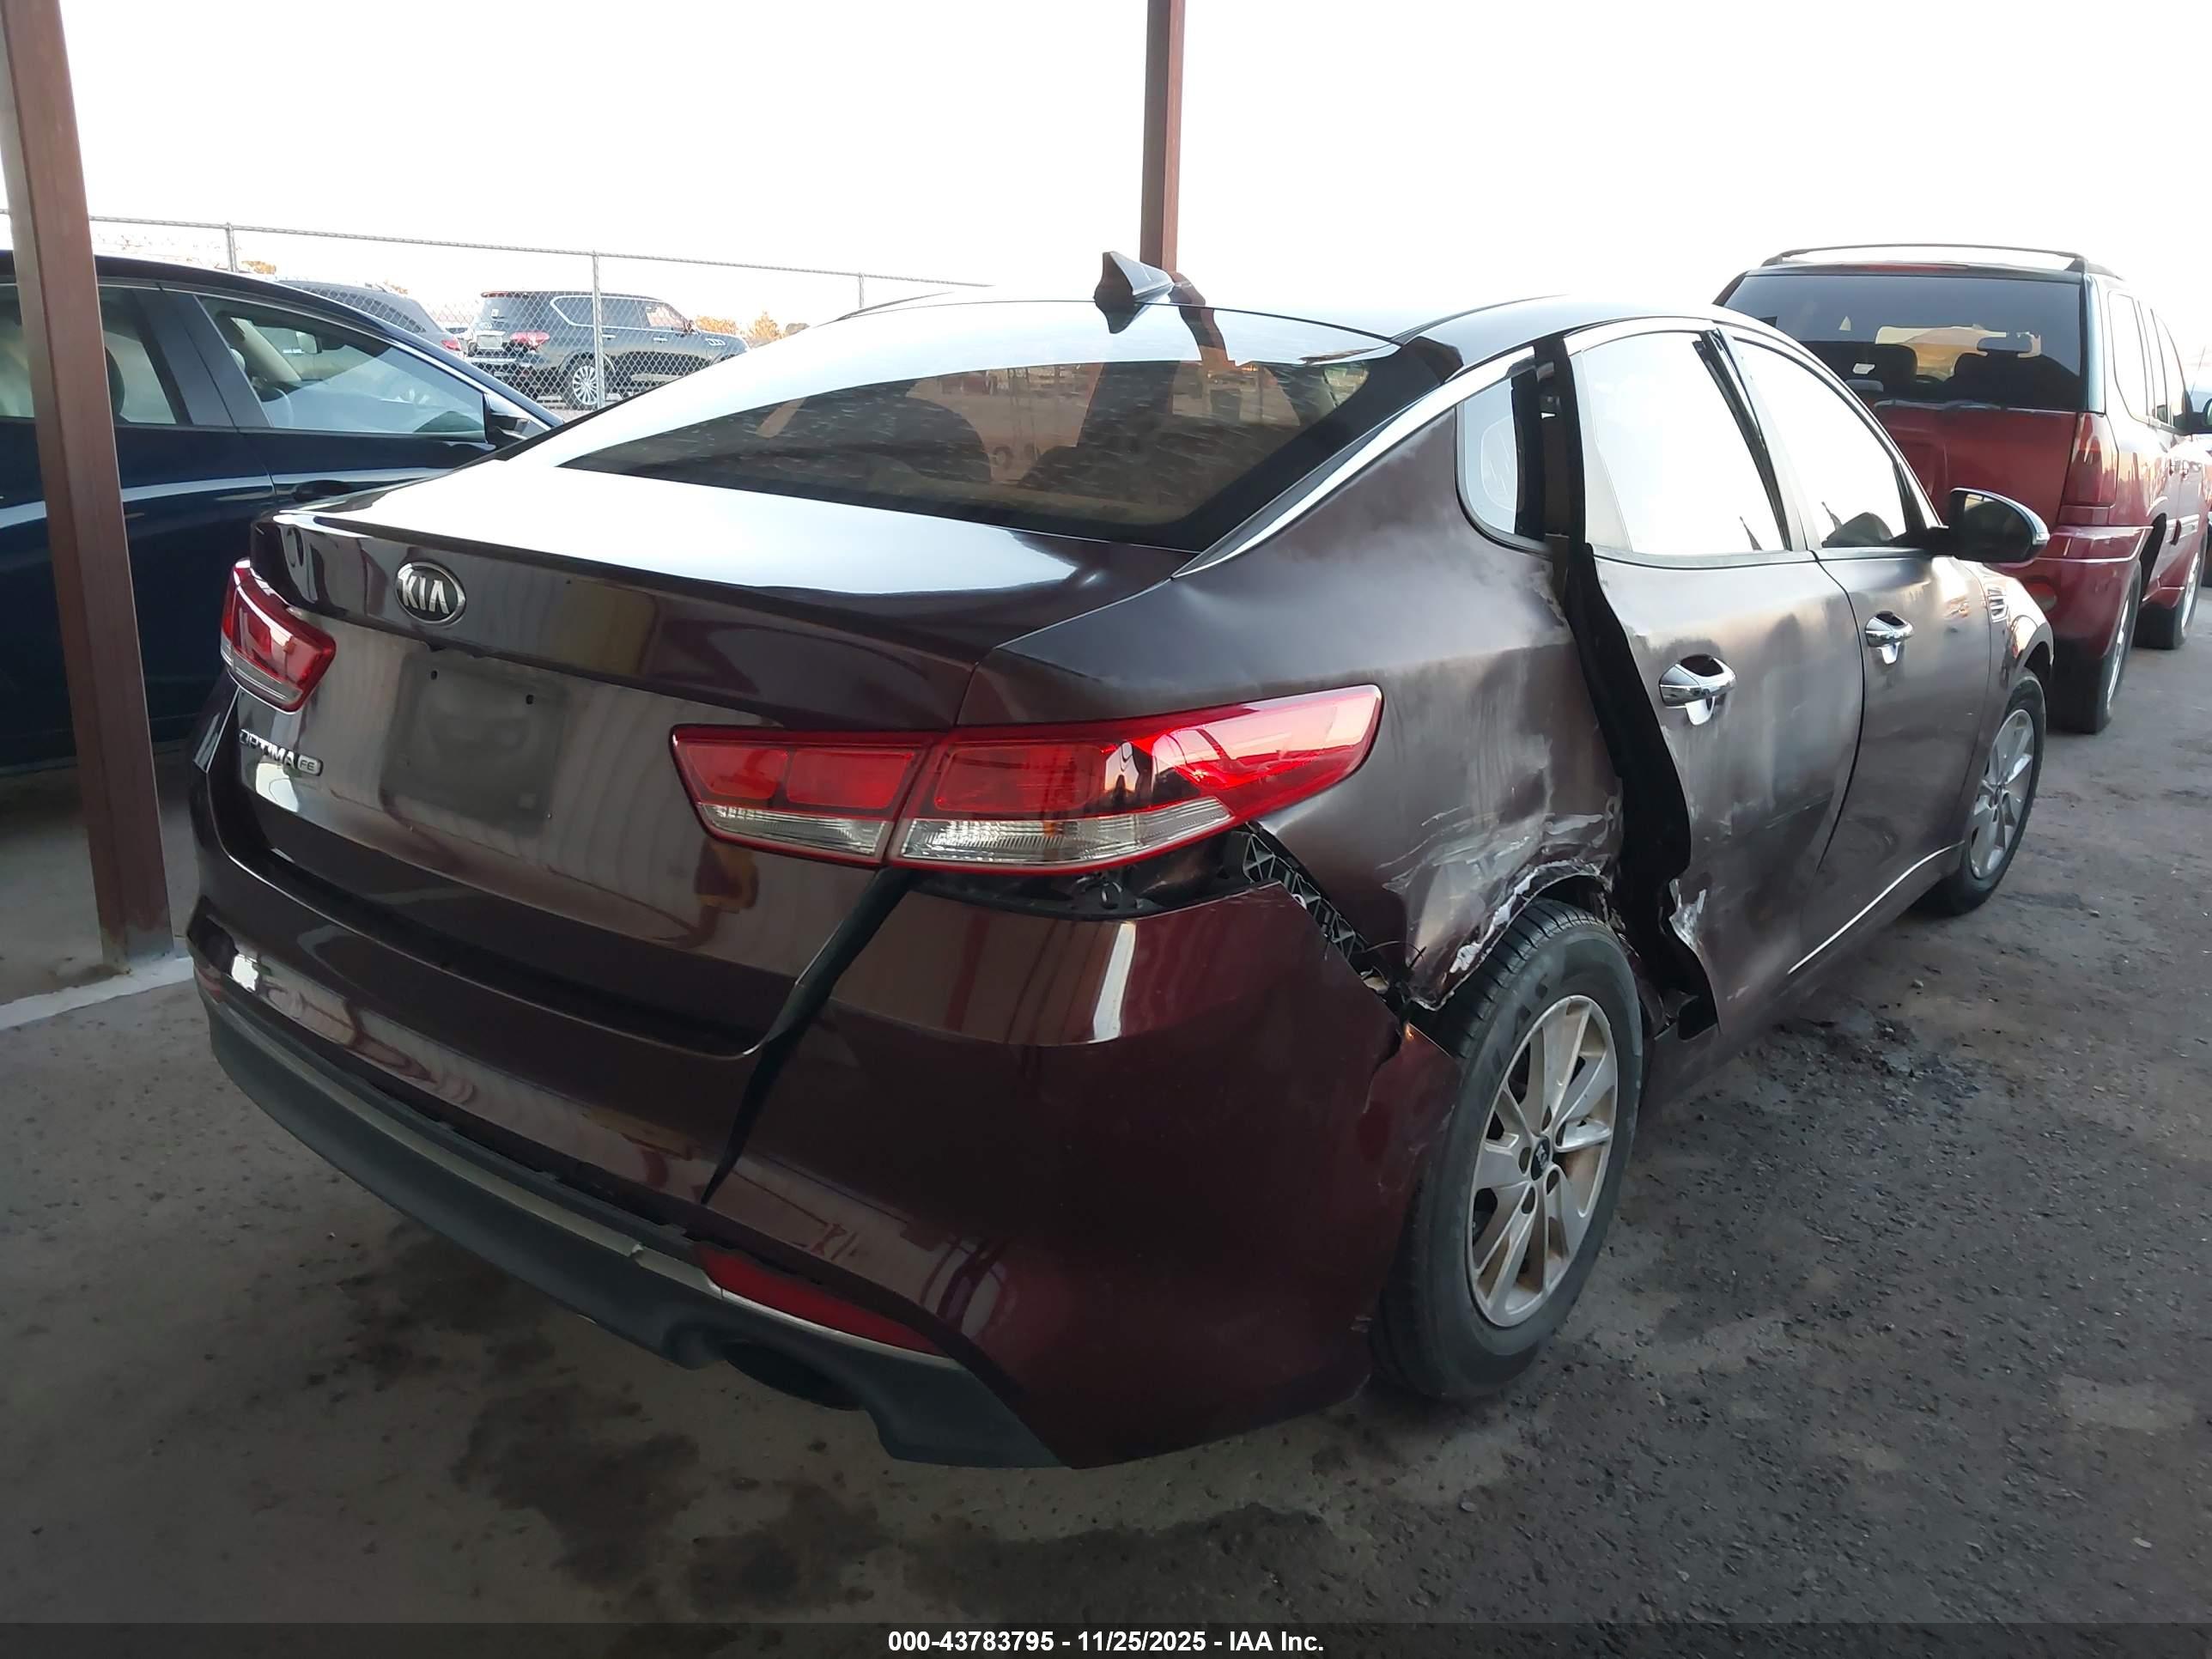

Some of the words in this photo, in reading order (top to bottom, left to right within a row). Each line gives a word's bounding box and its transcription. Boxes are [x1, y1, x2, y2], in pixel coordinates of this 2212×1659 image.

[400, 569, 450, 614] KIA
[240, 729, 295, 769] OPTIMA
[300, 759, 316, 772] FE
